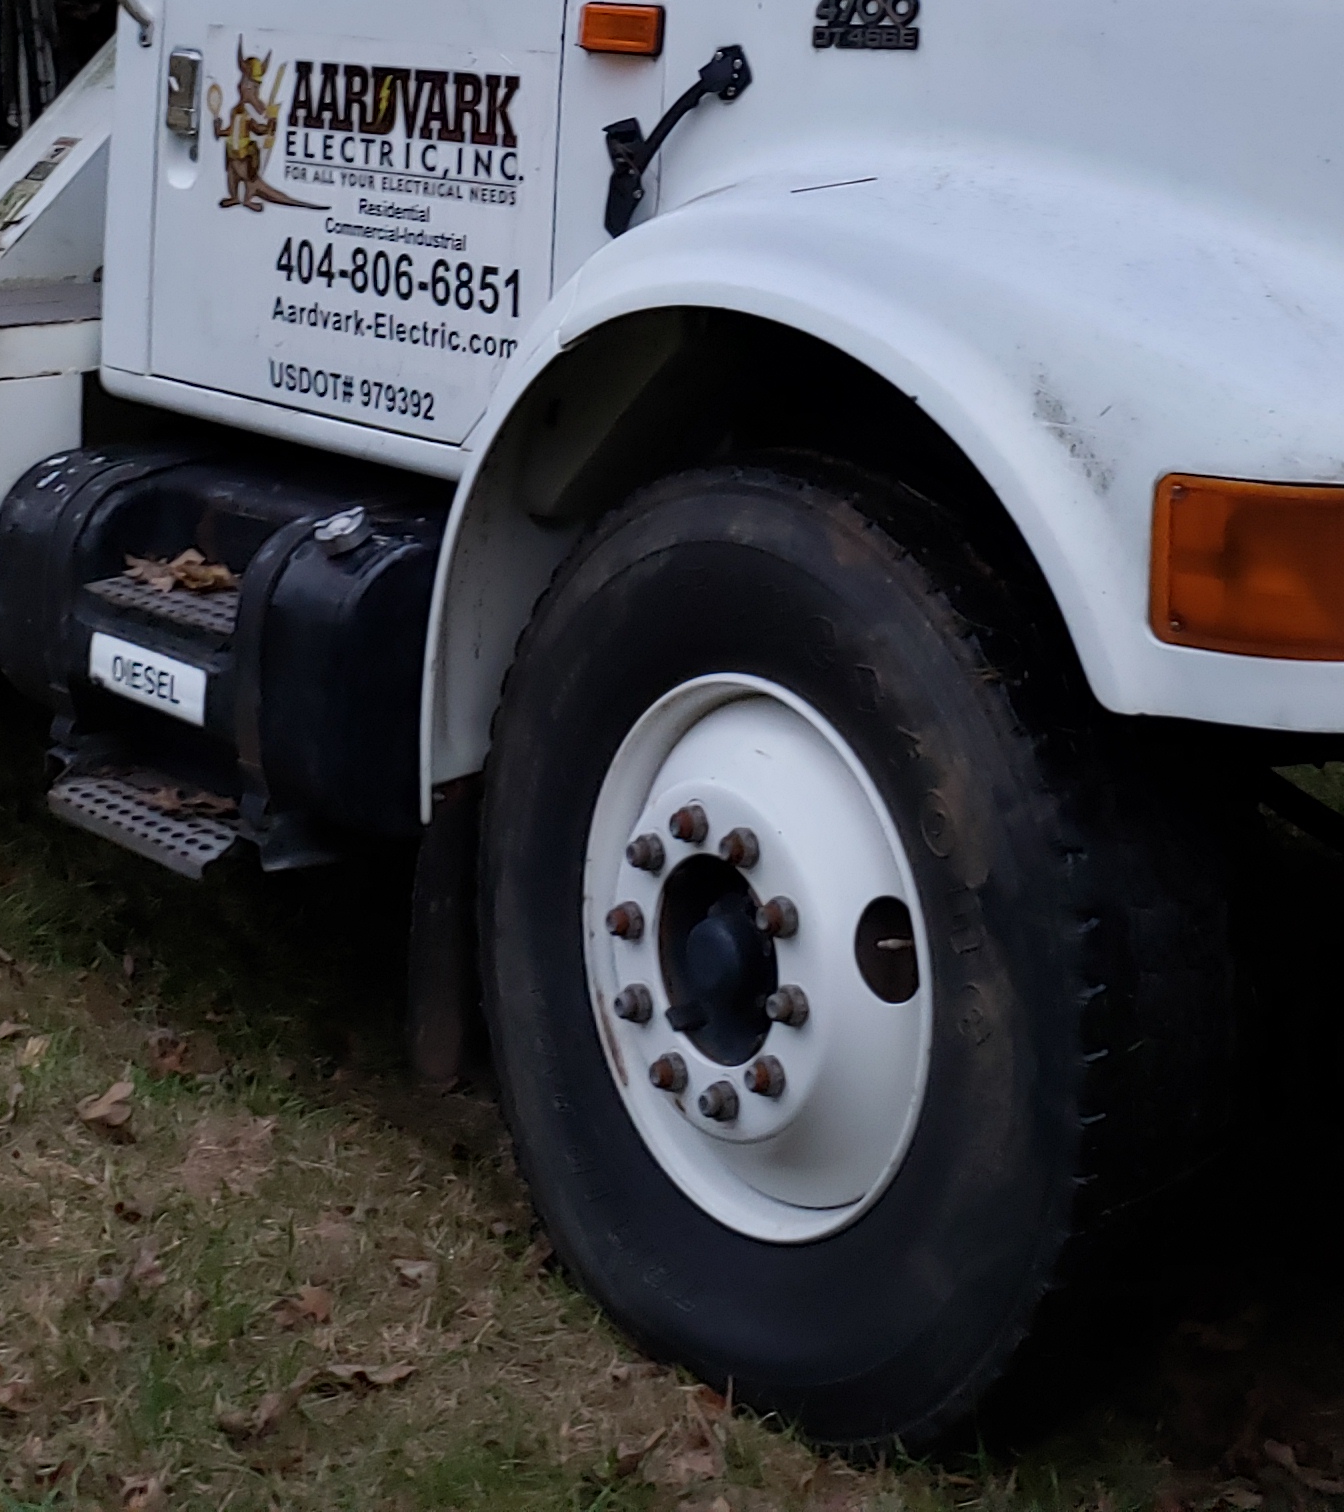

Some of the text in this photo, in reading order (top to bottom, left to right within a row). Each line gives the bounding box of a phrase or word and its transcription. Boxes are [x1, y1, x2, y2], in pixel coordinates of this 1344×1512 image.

[286, 60, 521, 149] AARDVARK
[284, 164, 517, 206] FOR ALL YOUR ELECTRICAL NEEDS
[359, 198, 430, 223] Residential
[276, 237, 521, 318] 404-806-6851
[271, 295, 518, 358] Aardvark-Electric.com
[268, 357, 436, 421] USDOT# 979392
[112, 655, 181, 705] DIESEL
